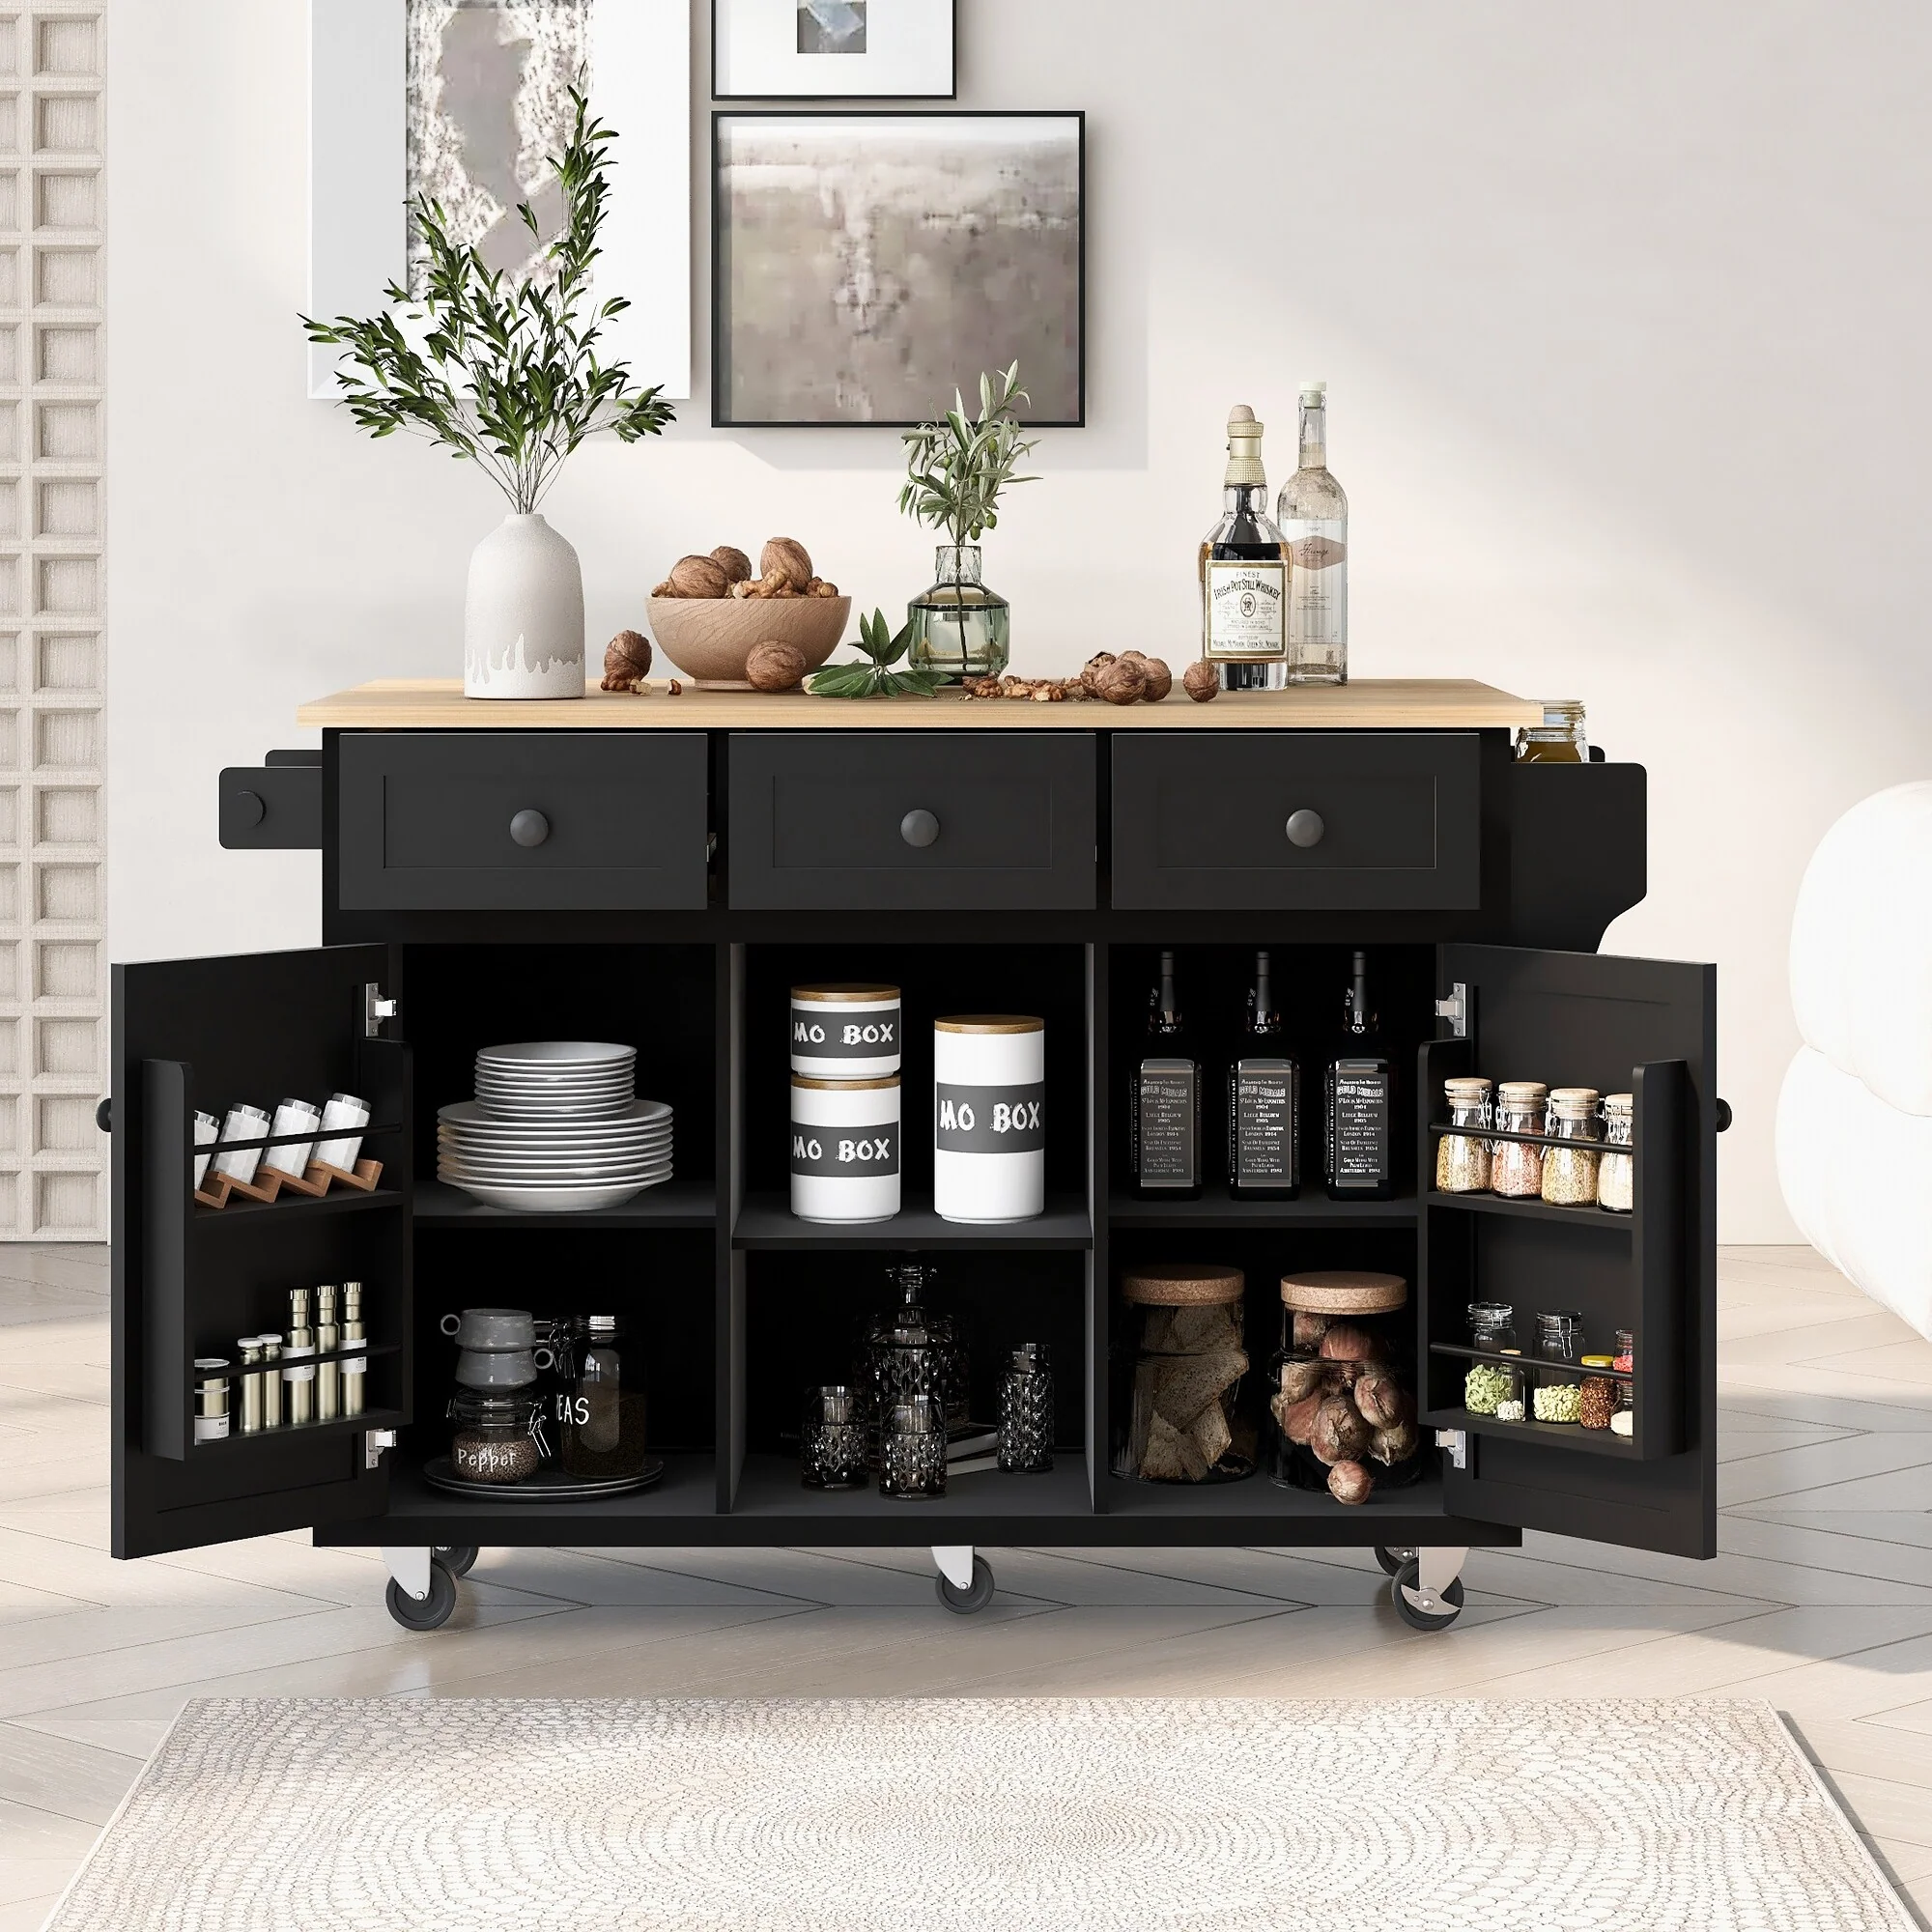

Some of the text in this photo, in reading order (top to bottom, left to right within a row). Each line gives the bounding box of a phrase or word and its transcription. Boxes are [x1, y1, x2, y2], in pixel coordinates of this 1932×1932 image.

[1230, 580, 1242, 592] POT
[1242, 578, 1255, 590] STILL
[1256, 579, 1281, 600] WHISKEY
[794, 1022, 893, 1045] MO BOX
[940, 1100, 1040, 1133] MO BOX
[793, 1136, 890, 1162] MO BOX
[458, 1448, 517, 1472] Pepper
